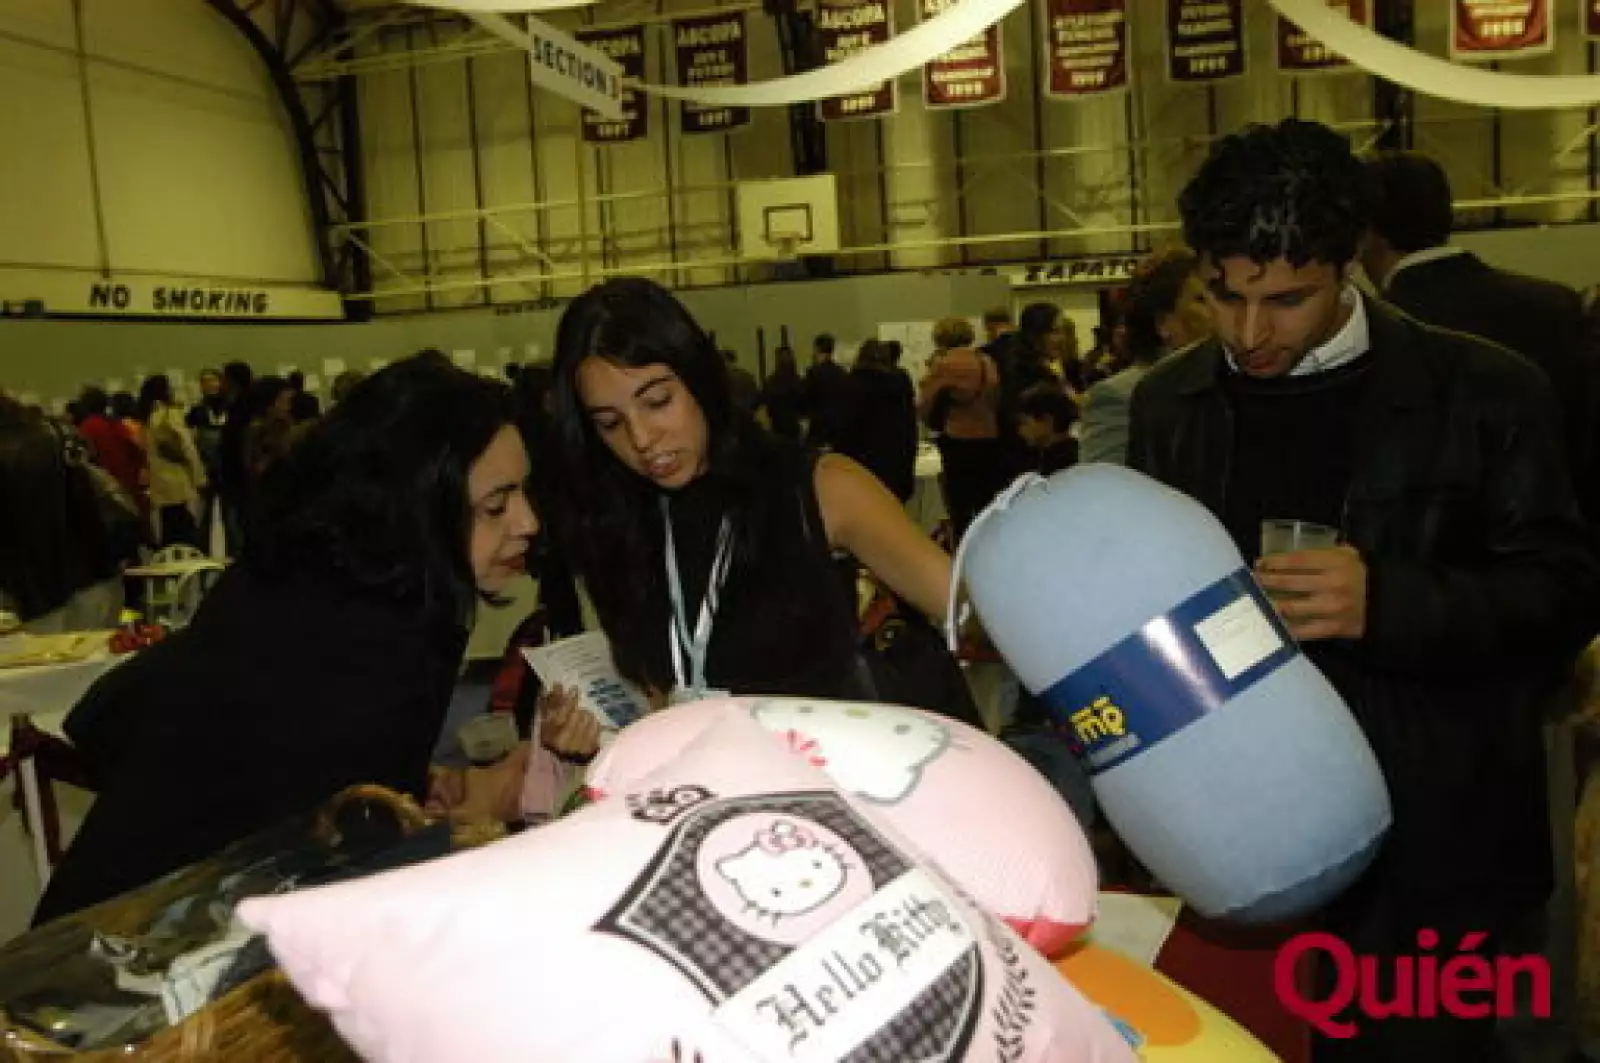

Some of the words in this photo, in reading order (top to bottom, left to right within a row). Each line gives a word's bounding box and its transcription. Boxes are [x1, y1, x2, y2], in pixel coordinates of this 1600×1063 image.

[533, 34, 607, 95] SECTION
[89, 284, 131, 309] NO
[152, 287, 270, 313] SMOKING
[756, 950, 883, 1056] Hello
[859, 895, 962, 967] Kitty
